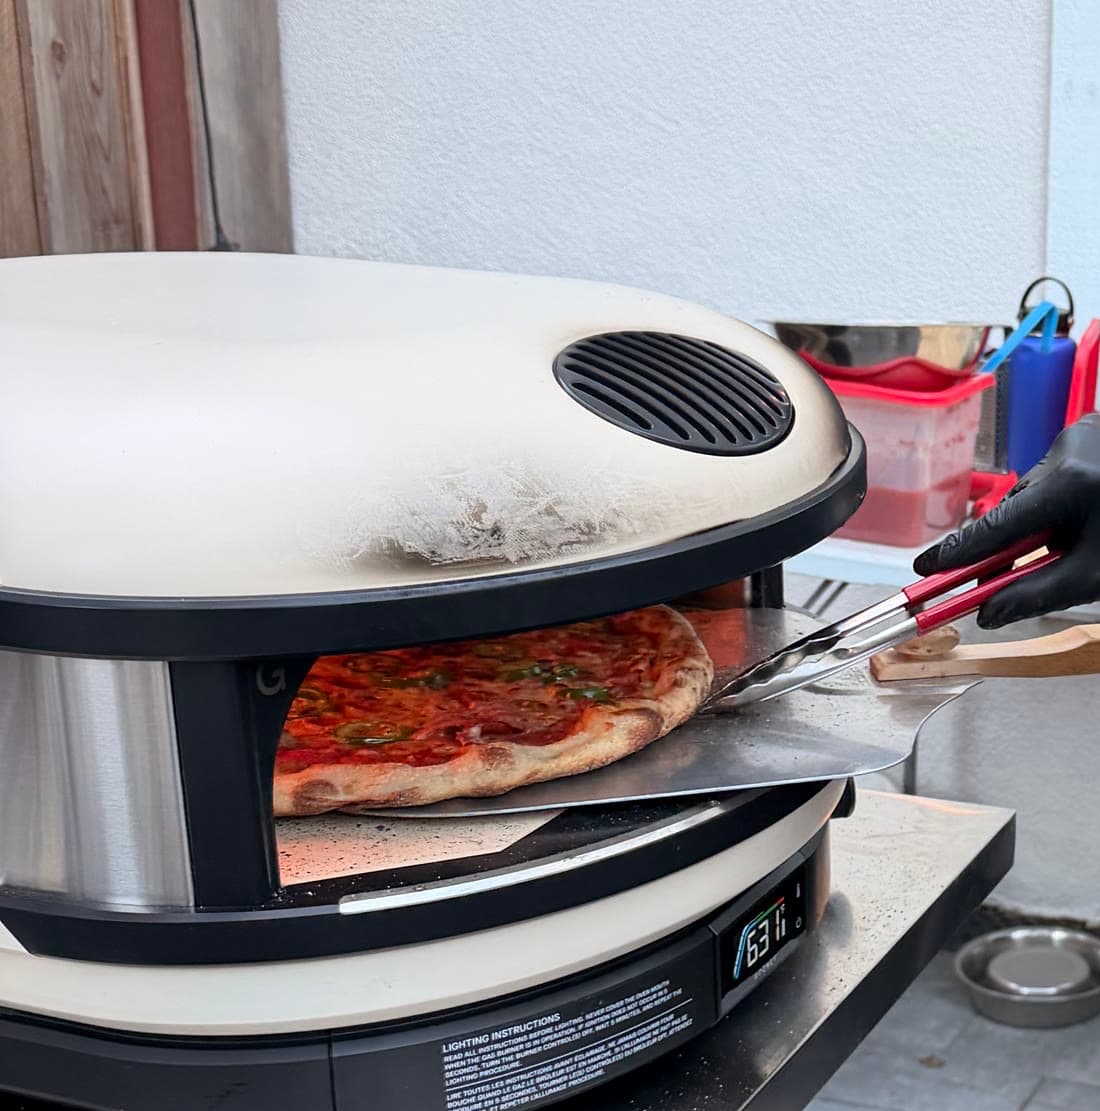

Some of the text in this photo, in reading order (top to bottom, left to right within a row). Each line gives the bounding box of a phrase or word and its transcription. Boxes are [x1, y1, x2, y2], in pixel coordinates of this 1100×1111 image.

[443, 1013, 560, 1053] LIGHTING INSTRUCTIONS
[444, 1053, 463, 1062] READ
[479, 1035, 528, 1053] INSTRUCTIONS
[529, 1027, 553, 1039] BEFORE
[586, 1008, 604, 1019] NEVER
[606, 1001, 624, 1012] COVER
[625, 996, 634, 1004] THE
[445, 1061, 465, 1070] WHEN
[497, 1044, 524, 1056] BURNER
[585, 1015, 610, 1027] IGNITION
[611, 1008, 626, 1017] DOES
[627, 1002, 638, 1011] NOT
[639, 993, 657, 1005] OCCUR
[516, 1047, 542, 1059] BURNER
[595, 1022, 609, 1031] WAIT
[642, 1003, 653, 1011] AND
[654, 993, 672, 1006] REPEAT
[446, 1061, 521, 1086] LIGHTING PROCEDURE.
[447, 1092, 461, 1100] LIRE
[463, 1085, 490, 1096] TOUTES
[491, 1081, 504, 1089] LES
[505, 1065, 552, 1084] INSTRUCTIONS
[554, 1058, 572, 1069] AVANT
[447, 1096, 475, 1108] BOUCHE
[478, 1090, 501, 1100] QUAND
[566, 1064, 576, 1072] EST
[539, 1076, 568, 1089] TOURNER
